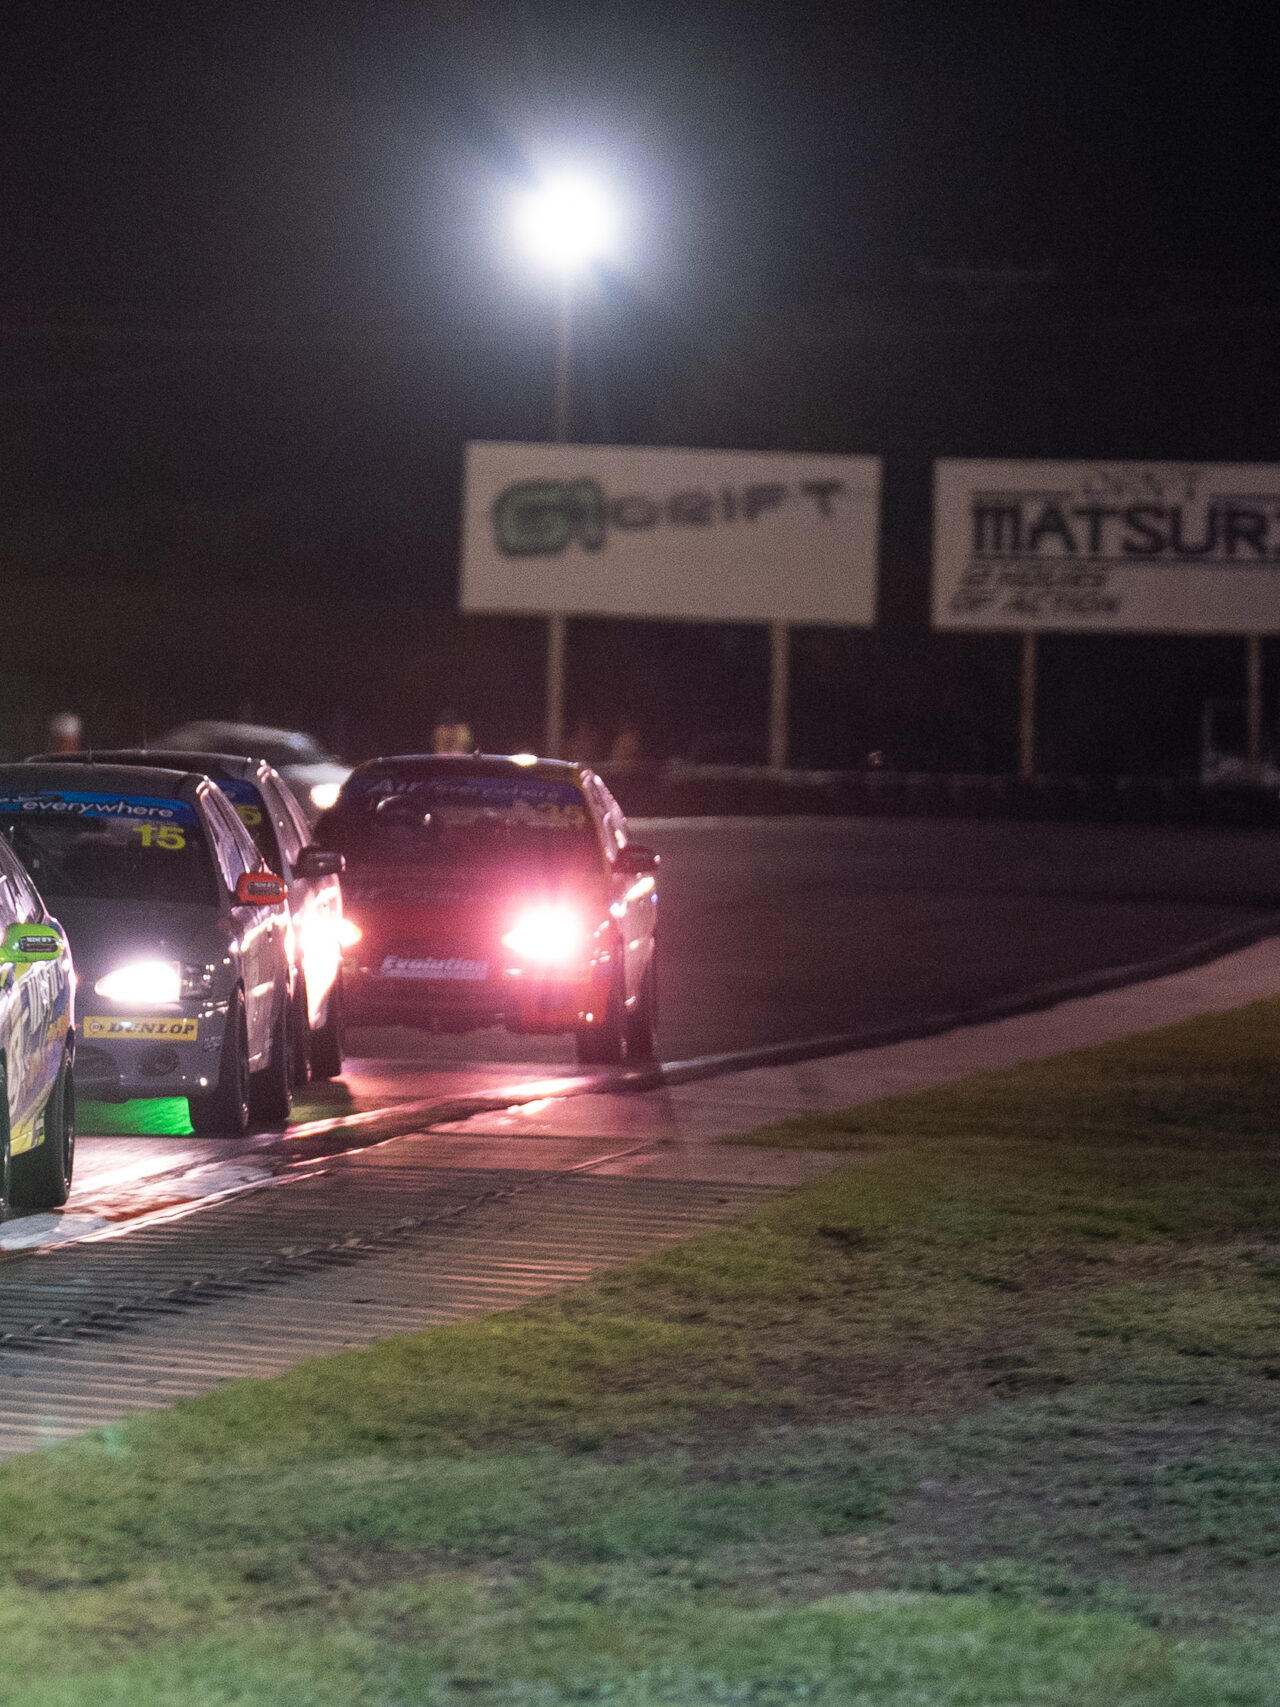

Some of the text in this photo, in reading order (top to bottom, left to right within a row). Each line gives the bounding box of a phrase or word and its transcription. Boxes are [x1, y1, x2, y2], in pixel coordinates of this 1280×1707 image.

[970, 500, 1280, 556] MATSUR
[22, 799, 174, 817] everywhere
[133, 824, 186, 849] 15
[107, 1020, 195, 1035] DUNLOP
